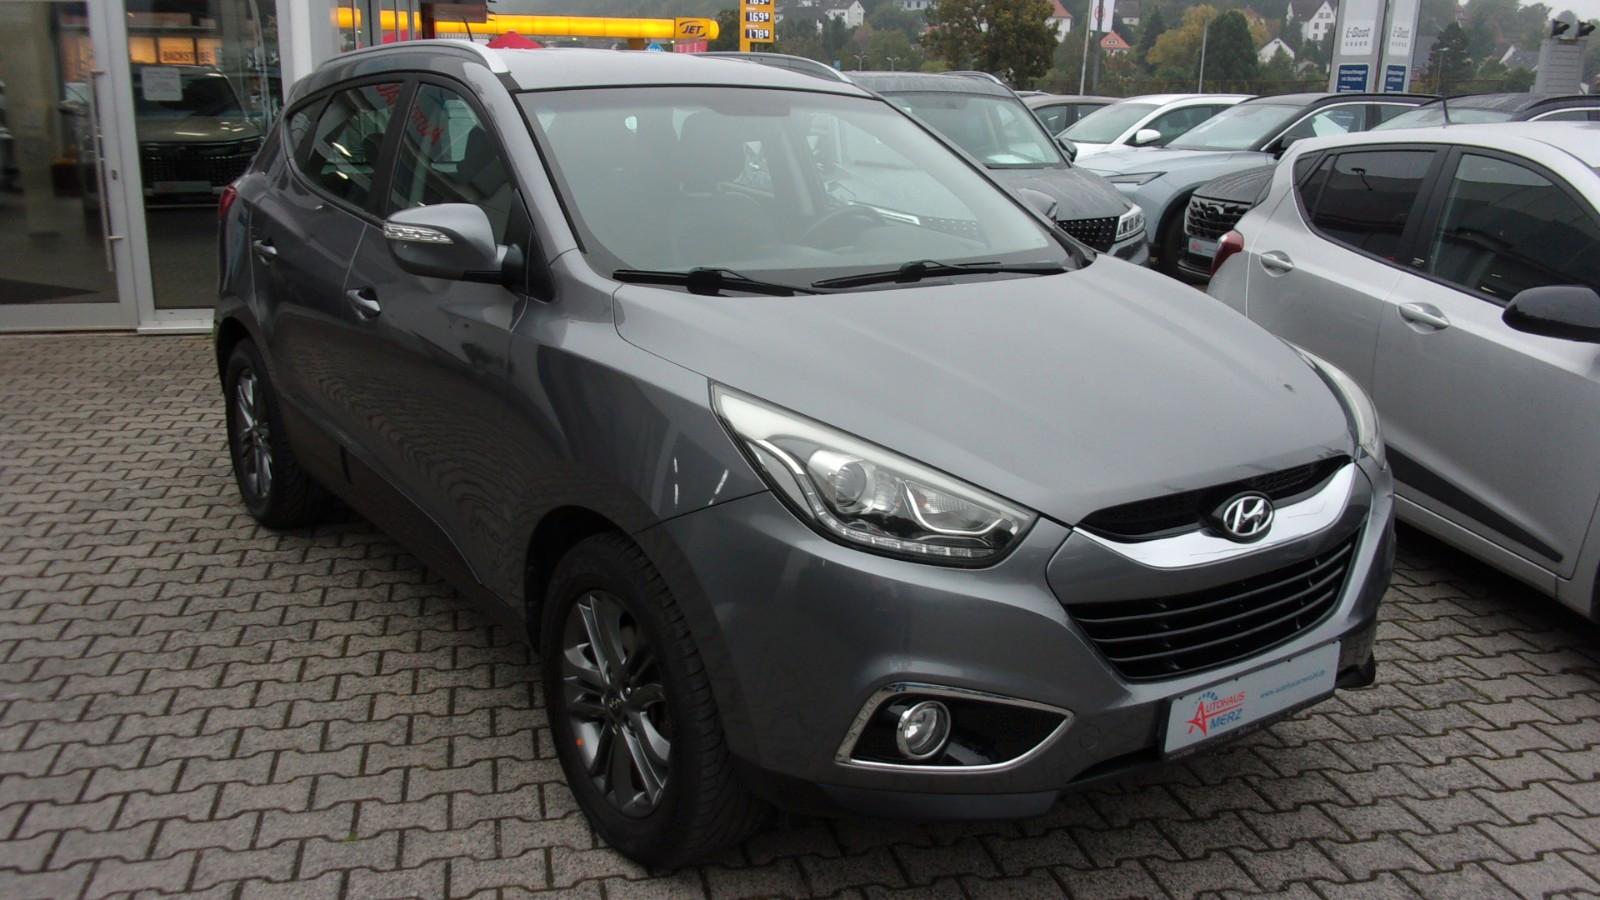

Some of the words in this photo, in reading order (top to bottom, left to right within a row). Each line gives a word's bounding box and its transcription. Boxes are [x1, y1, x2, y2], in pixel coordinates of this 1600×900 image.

[681, 25, 704, 34] JET
[163, 51, 209, 62] BACKSTBE
[1185, 690, 1247, 736] AUTOHAUS
[1210, 708, 1243, 729] MERZ
